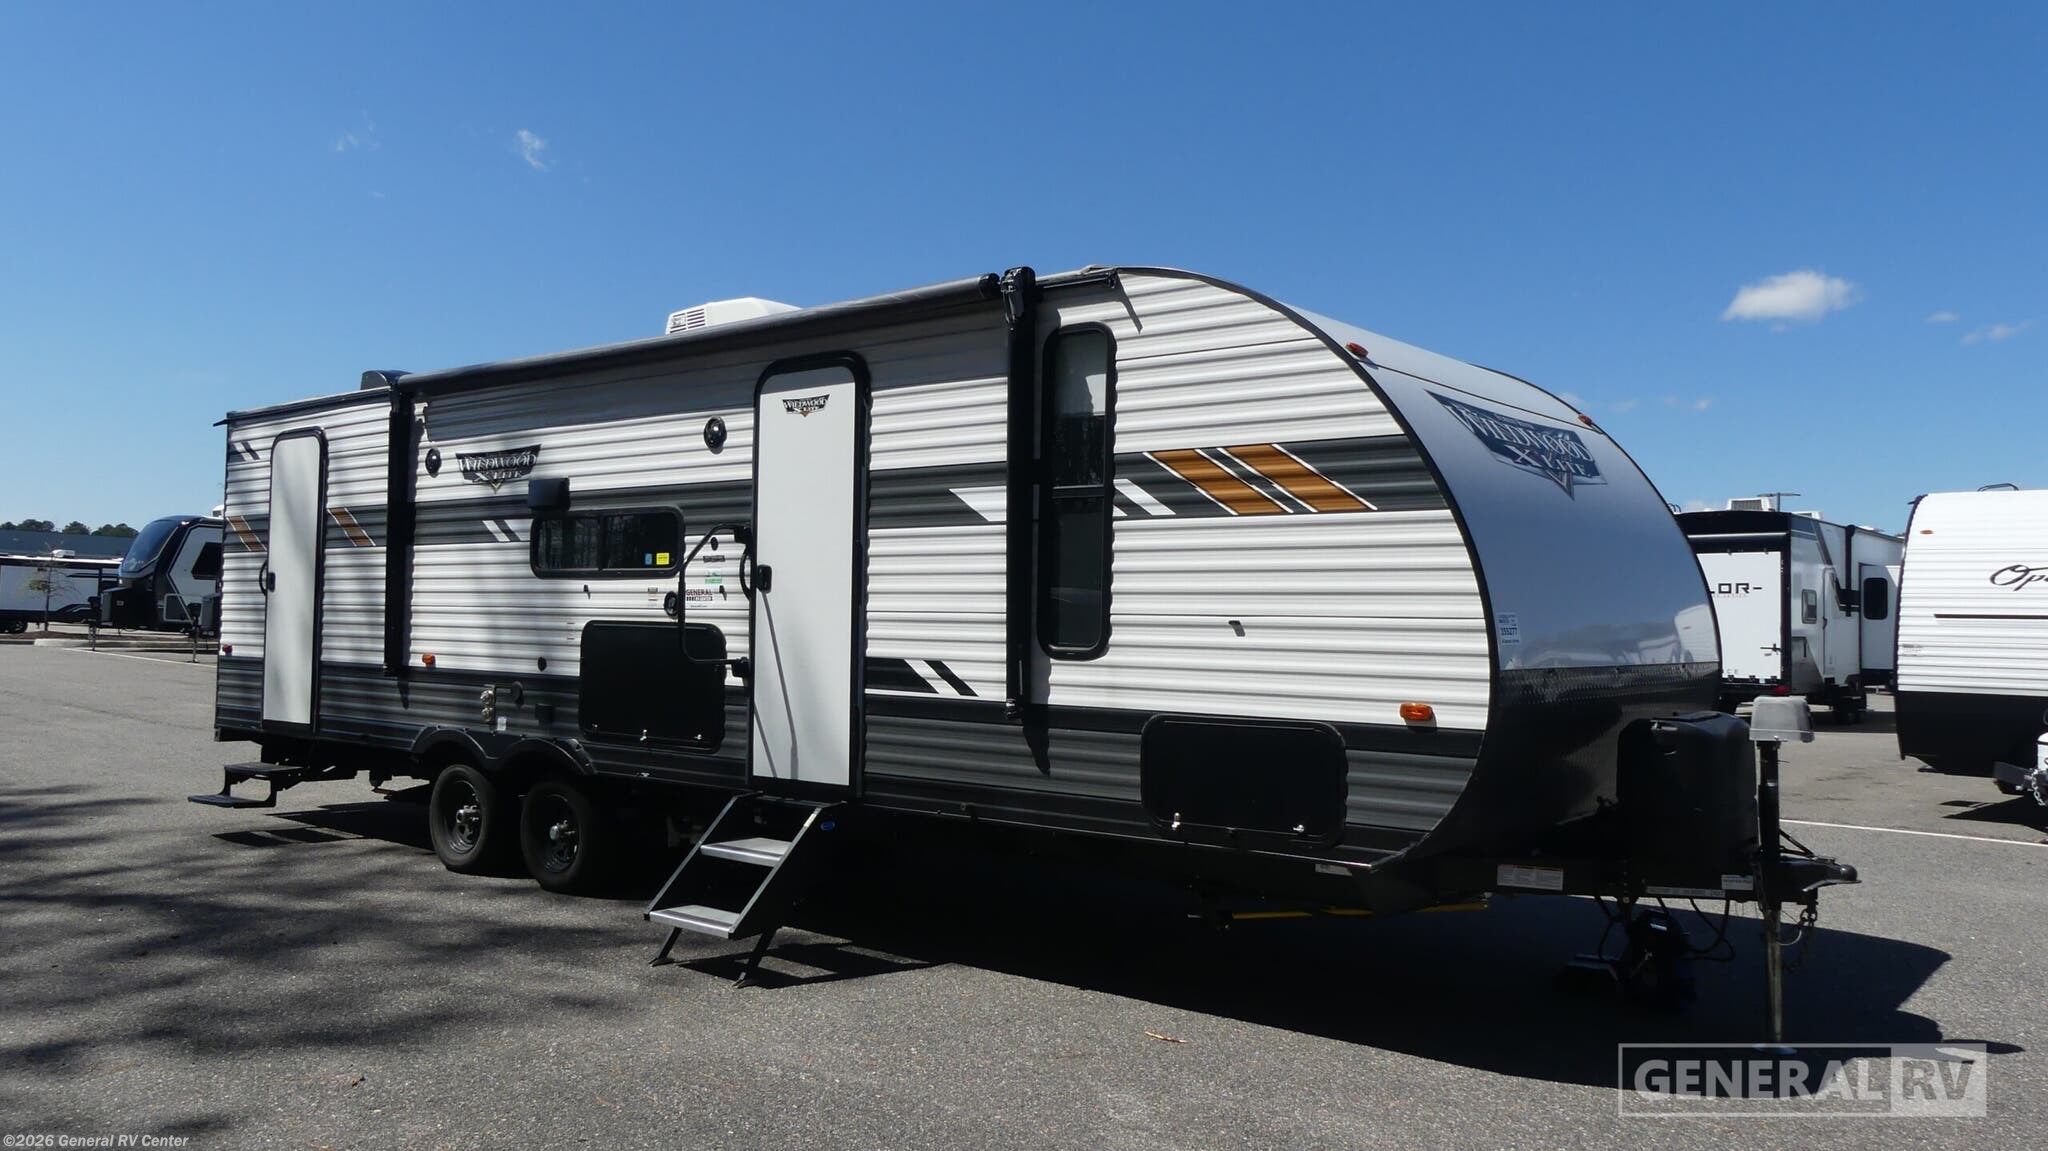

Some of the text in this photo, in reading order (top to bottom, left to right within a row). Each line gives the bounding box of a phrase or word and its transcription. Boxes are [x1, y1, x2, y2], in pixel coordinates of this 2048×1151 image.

[1442, 403, 1595, 462] WILDWOOD
[686, 588, 713, 596] GENERAL
[1990, 564, 2048, 592] Op
